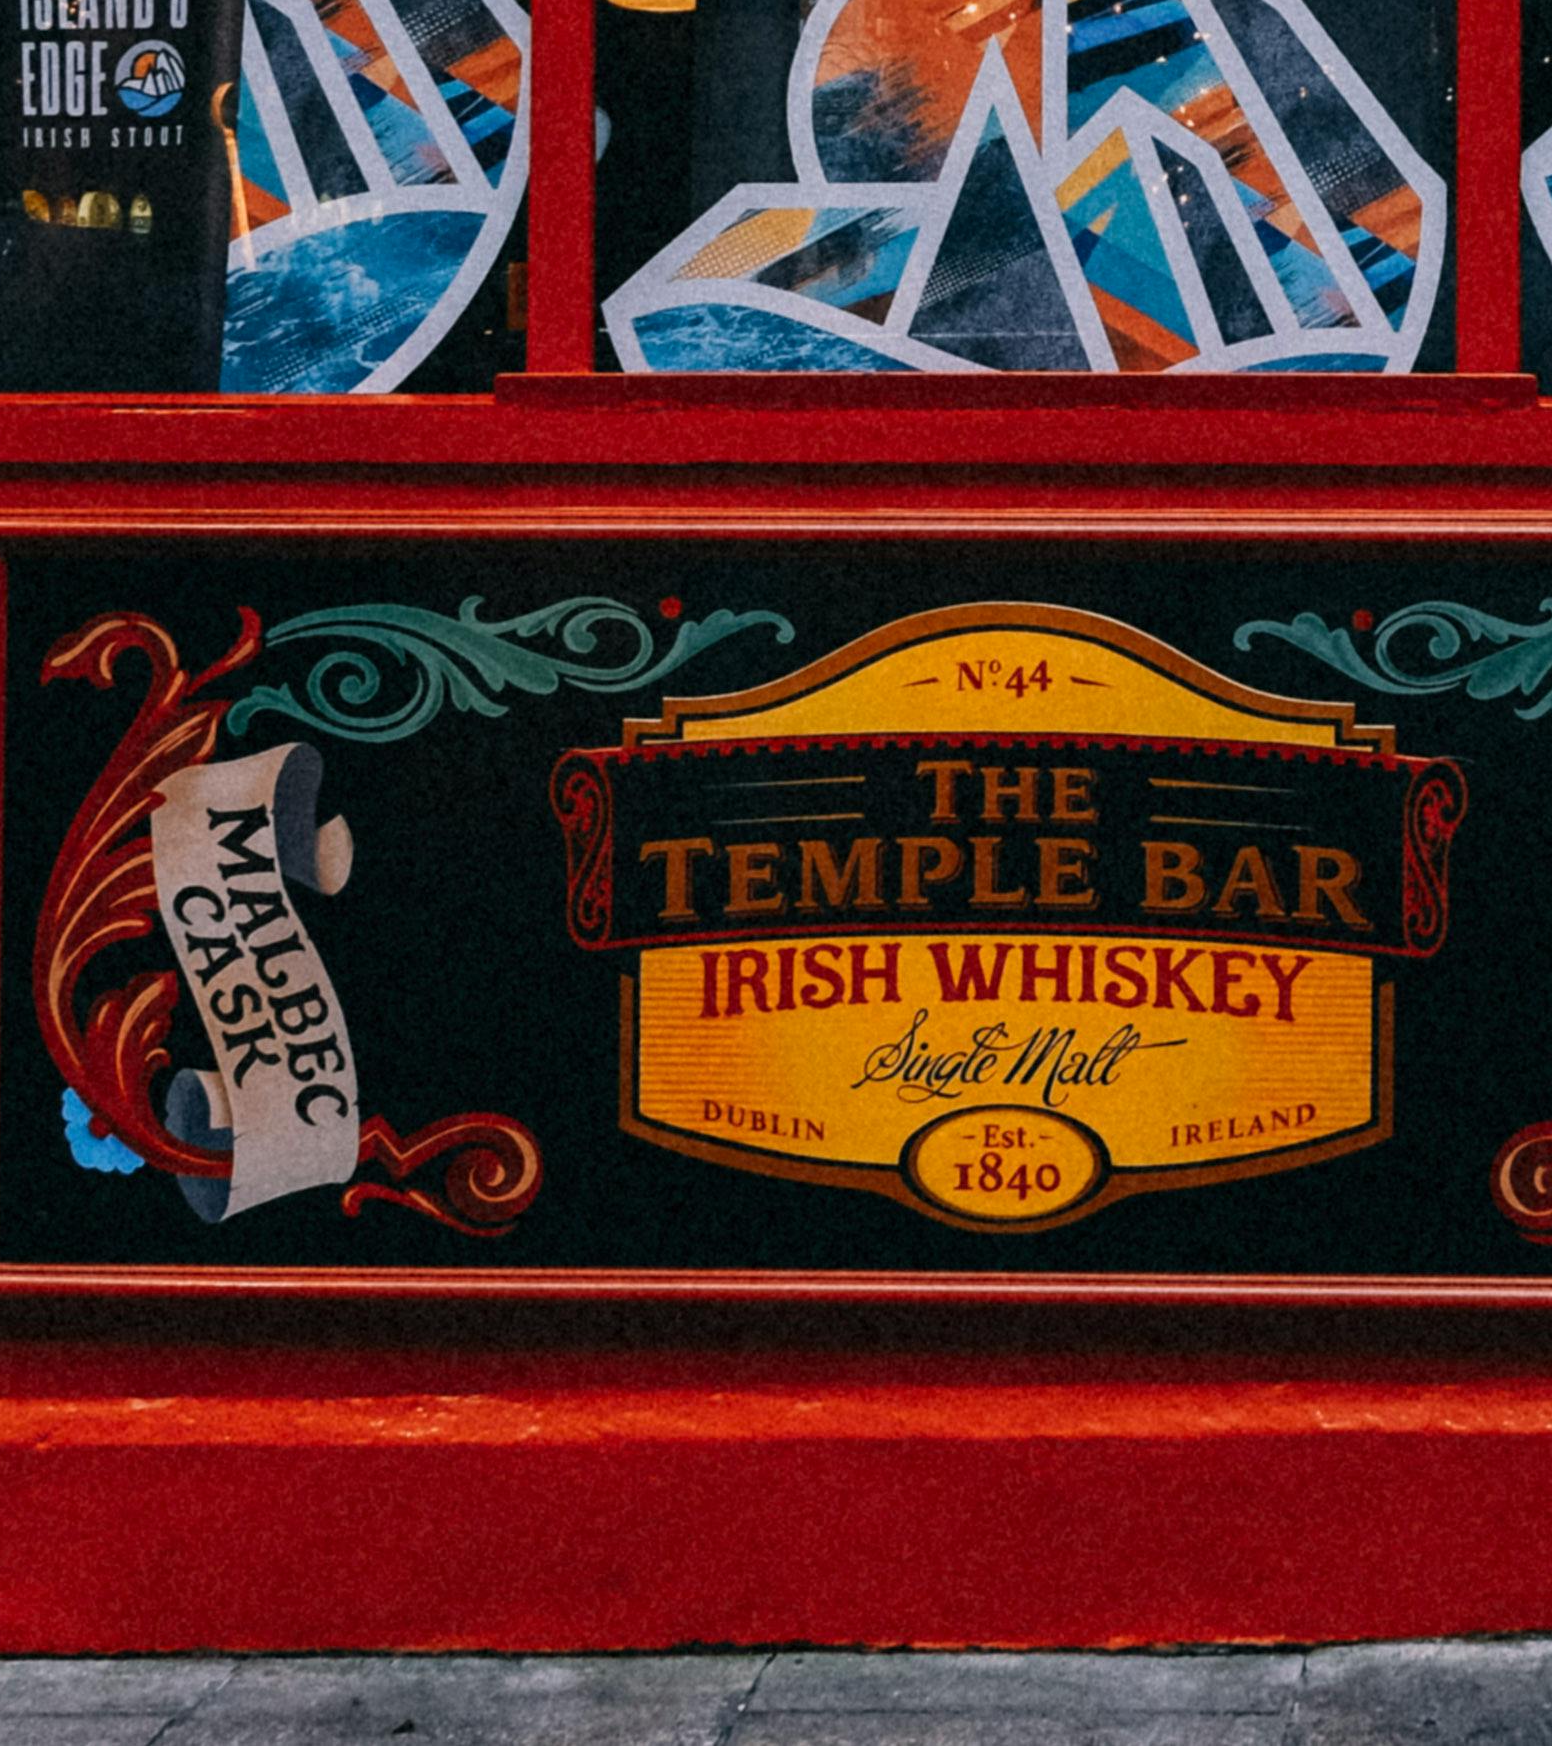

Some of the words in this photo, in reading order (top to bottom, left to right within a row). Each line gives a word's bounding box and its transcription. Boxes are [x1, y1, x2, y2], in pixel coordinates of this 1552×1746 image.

[22, 42, 107, 117] EDGE
[22, 126, 91, 149] IRISH
[111, 124, 186, 148] STOUT
[917, 760, 1100, 825] THE
[640, 836, 1100, 921] TEMPLE
[1142, 839, 1374, 931] BAR
[171, 885, 290, 1090] CASK
[206, 805, 349, 1129] MALBEC
[699, 942, 902, 1020] IRISH
[928, 943, 1314, 1023] WHISKEY
[851, 1009, 1003, 1101] Single
[1003, 1023, 1187, 1107] Malt
[701, 1099, 827, 1143] DUBLIN
[982, 1124, 1034, 1151] Est.
[1170, 1103, 1318, 1148] IRELAND
[952, 1152, 1063, 1201] 1840
